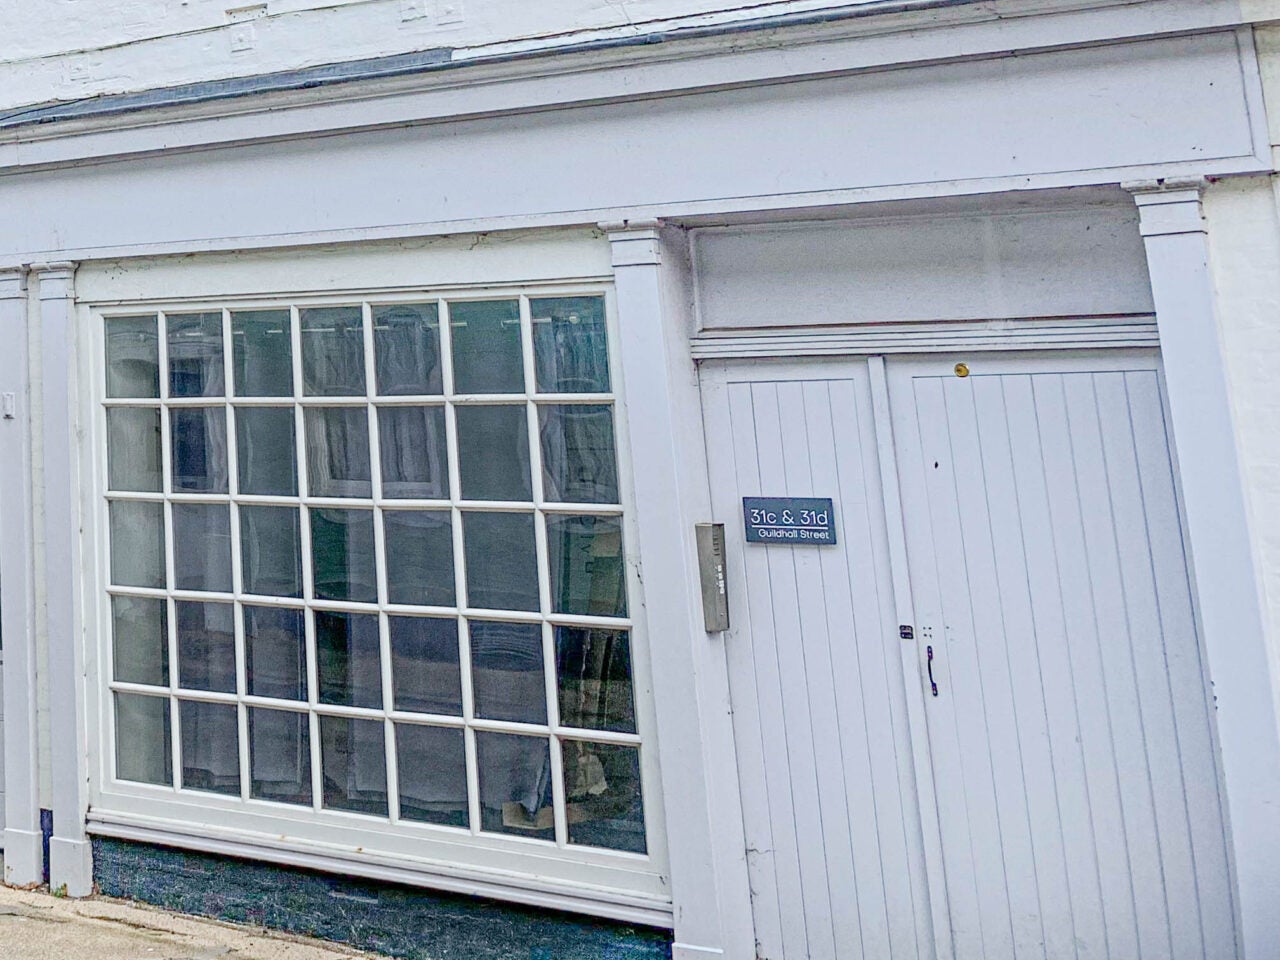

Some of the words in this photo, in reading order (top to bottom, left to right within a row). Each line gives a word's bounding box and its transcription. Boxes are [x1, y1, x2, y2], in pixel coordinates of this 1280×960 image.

[750, 509, 777, 524] 31c
[782, 509, 795, 524] &
[800, 510, 828, 525] 31d
[758, 528, 798, 538] Guildhall
[800, 529, 829, 540] Street
